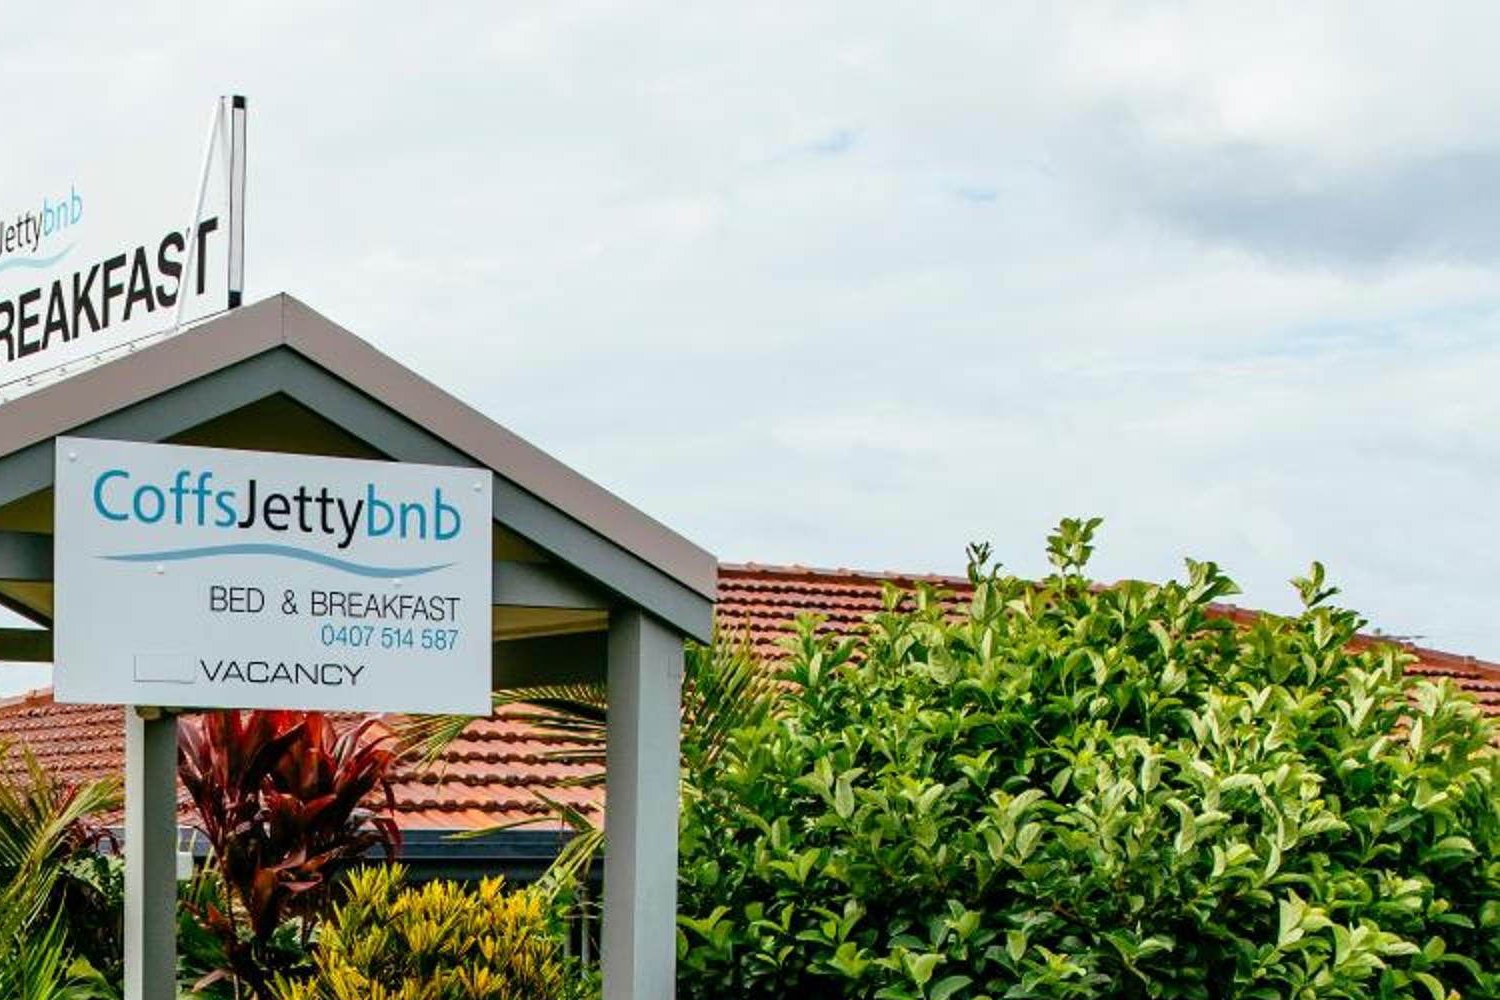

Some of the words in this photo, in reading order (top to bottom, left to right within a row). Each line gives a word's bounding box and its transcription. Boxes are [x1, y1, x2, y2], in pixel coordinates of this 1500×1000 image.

[93, 469, 461, 548] CoffsJettybnb
[209, 585, 264, 613] BED
[281, 590, 299, 615] &
[311, 591, 460, 621] BREAKFAST
[321, 624, 375, 646] 0407
[381, 627, 414, 648] 514
[421, 629, 459, 650] 587
[200, 660, 365, 686] VACANCY
